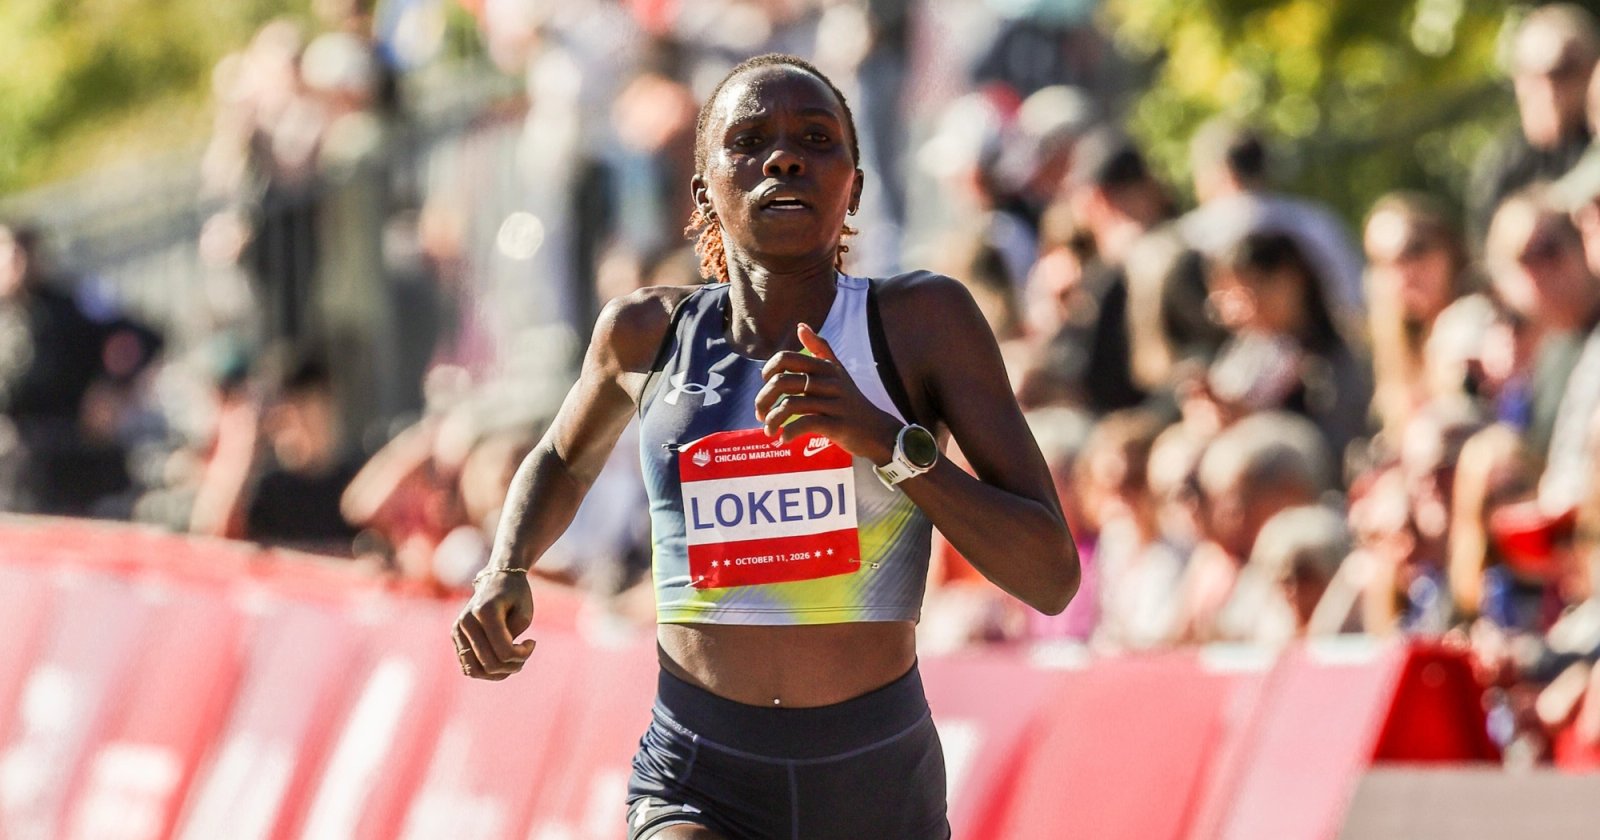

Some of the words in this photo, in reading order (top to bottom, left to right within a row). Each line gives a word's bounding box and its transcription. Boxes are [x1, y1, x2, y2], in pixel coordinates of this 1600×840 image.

[741, 443, 770, 451] AMERICA
[808, 437, 830, 448] RUN
[714, 453, 747, 463] CHICAGO
[748, 449, 791, 460] MARATHON
[691, 483, 846, 530] LOKEDI
[735, 555, 774, 566] OCTOBER
[776, 554, 788, 563] 11,
[789, 552, 810, 561] 2026
